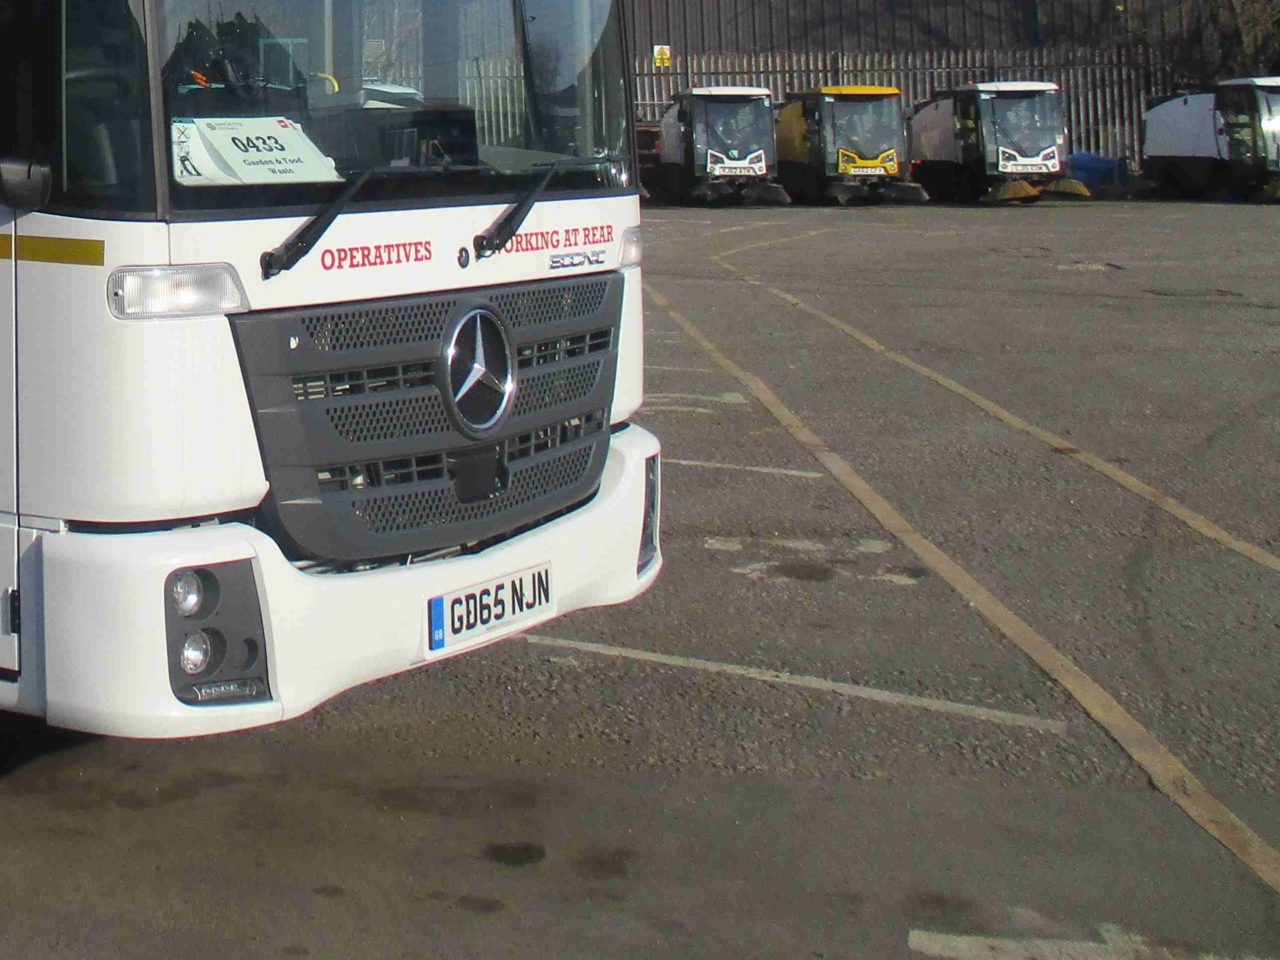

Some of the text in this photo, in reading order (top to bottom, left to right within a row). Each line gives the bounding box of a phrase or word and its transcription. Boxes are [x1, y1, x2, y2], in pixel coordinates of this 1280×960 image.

[231, 136, 286, 153] 0433
[243, 158, 274, 166] Garden
[268, 167, 295, 175] Waste
[320, 224, 614, 271] OPERATIVES ORKING AT REAR
[450, 568, 550, 635] GD65 NJN
